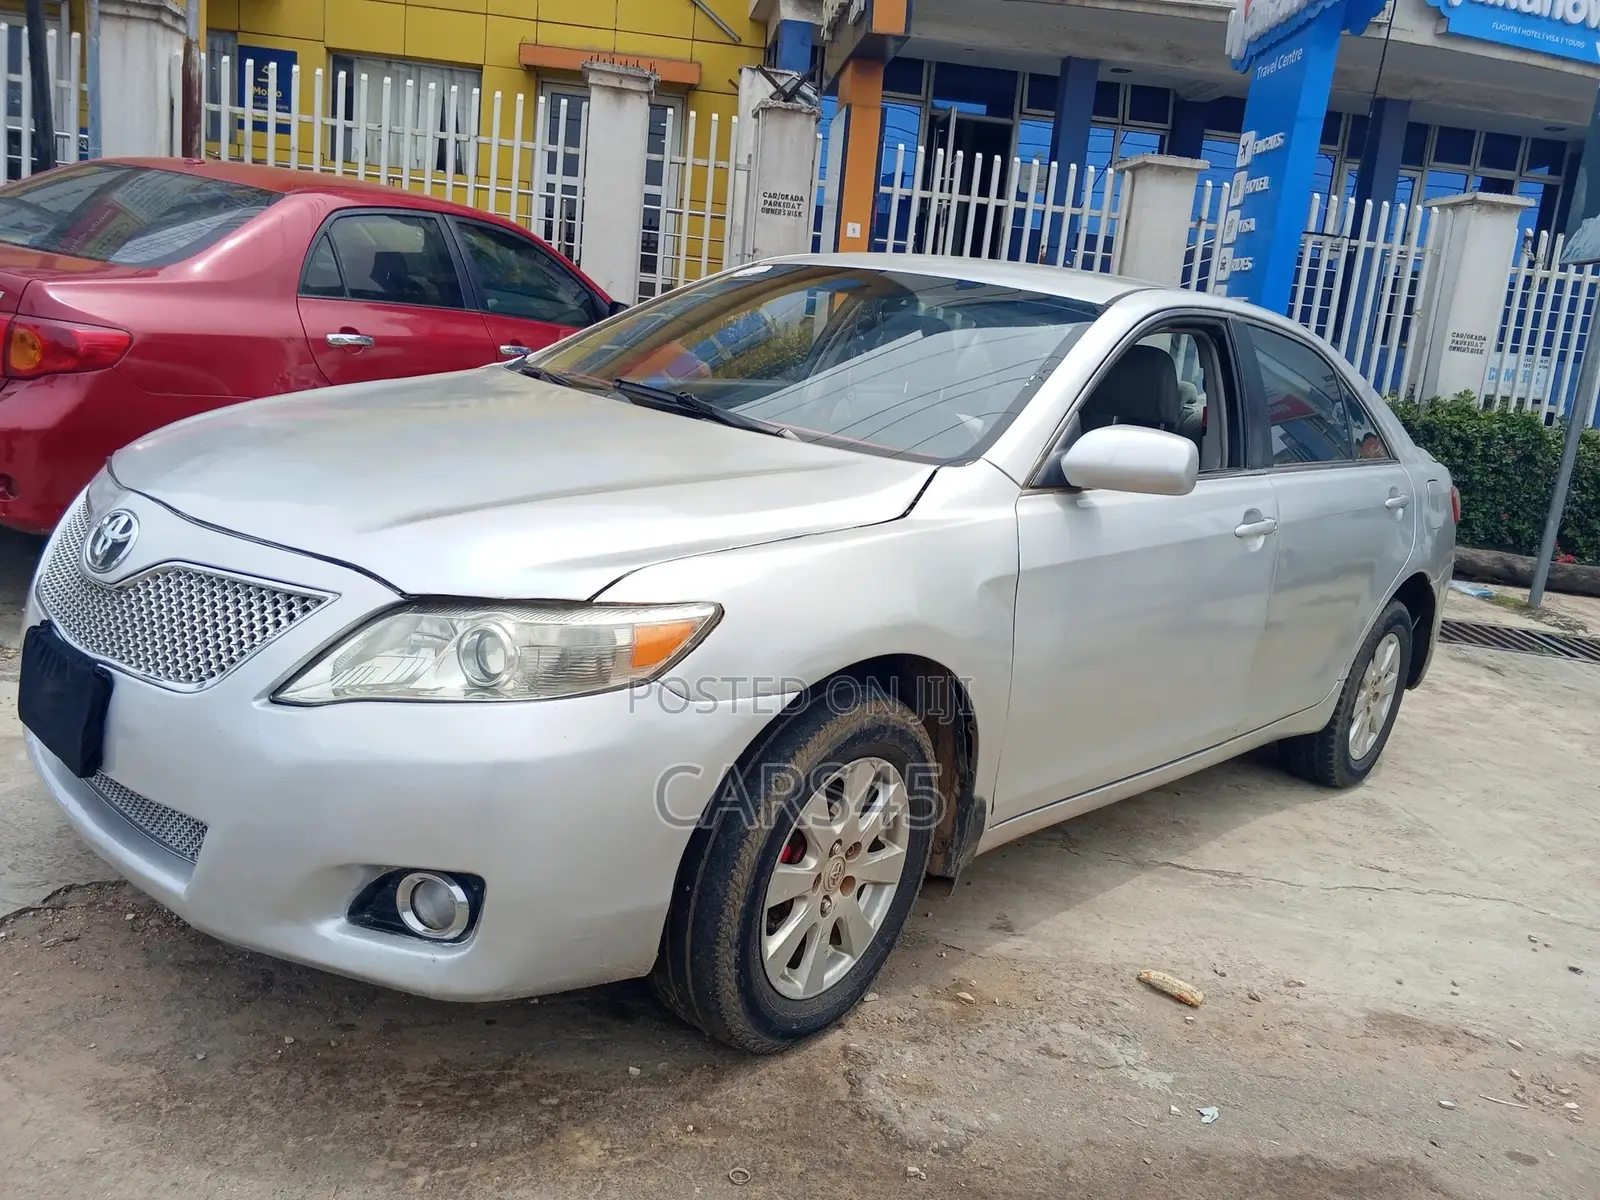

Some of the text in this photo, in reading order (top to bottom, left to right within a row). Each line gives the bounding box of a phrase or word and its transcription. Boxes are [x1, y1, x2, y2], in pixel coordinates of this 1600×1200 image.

[1492, 21, 1517, 34] FLIGHTS
[1522, 28, 1541, 41] HOTEL
[1545, 33, 1560, 44] VISA
[1564, 38, 1586, 49] TOURS
[1256, 48, 1303, 81] Travel Centre
[1252, 132, 1285, 155] FLIGHTS
[1245, 176, 1270, 194] HOTEL
[762, 191, 804, 203] CAR/OKADA
[763, 199, 791, 209] PARKED
[787, 209, 803, 218] RISK
